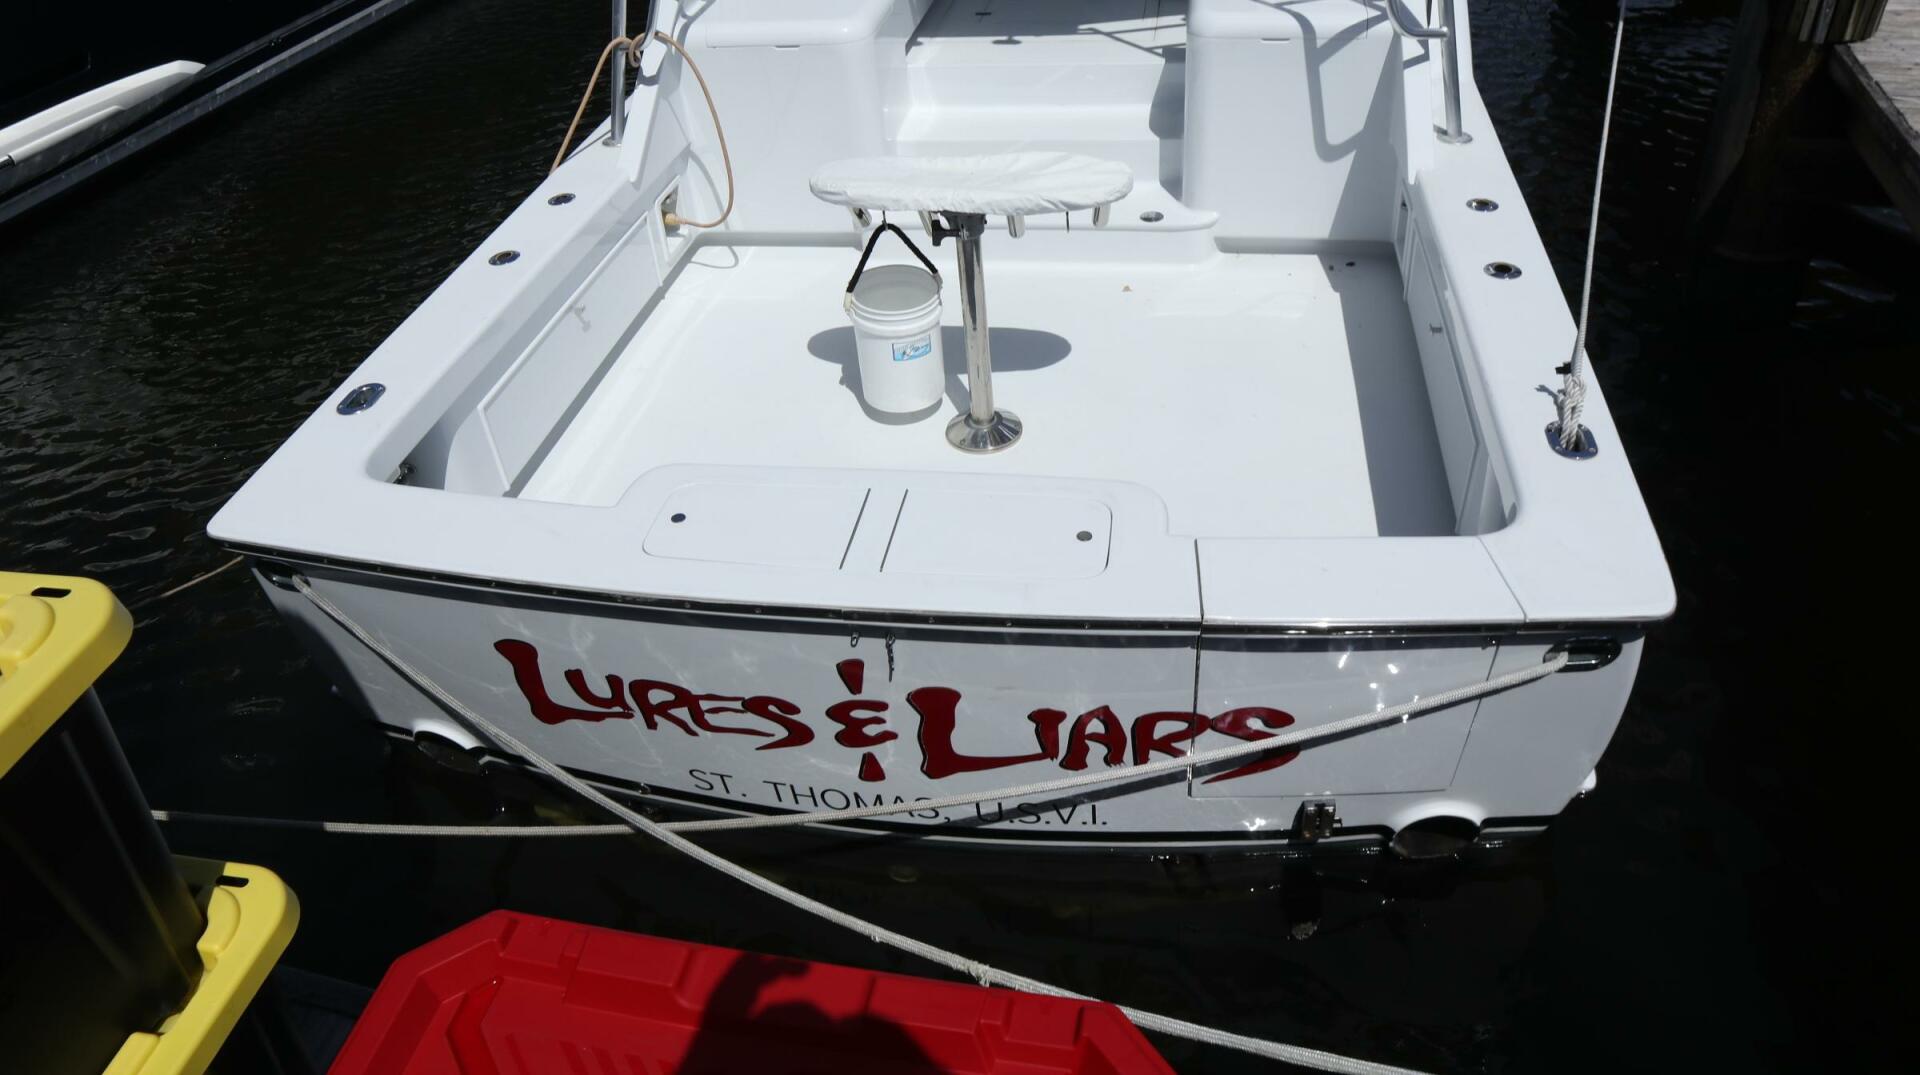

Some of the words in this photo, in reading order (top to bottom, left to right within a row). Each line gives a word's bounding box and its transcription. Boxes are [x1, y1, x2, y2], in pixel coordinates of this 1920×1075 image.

[826, 658, 899, 782] &
[906, 686, 1299, 782] LIARS
[689, 769, 747, 797] ST.
[976, 801, 1108, 825] U.S.V.I.
